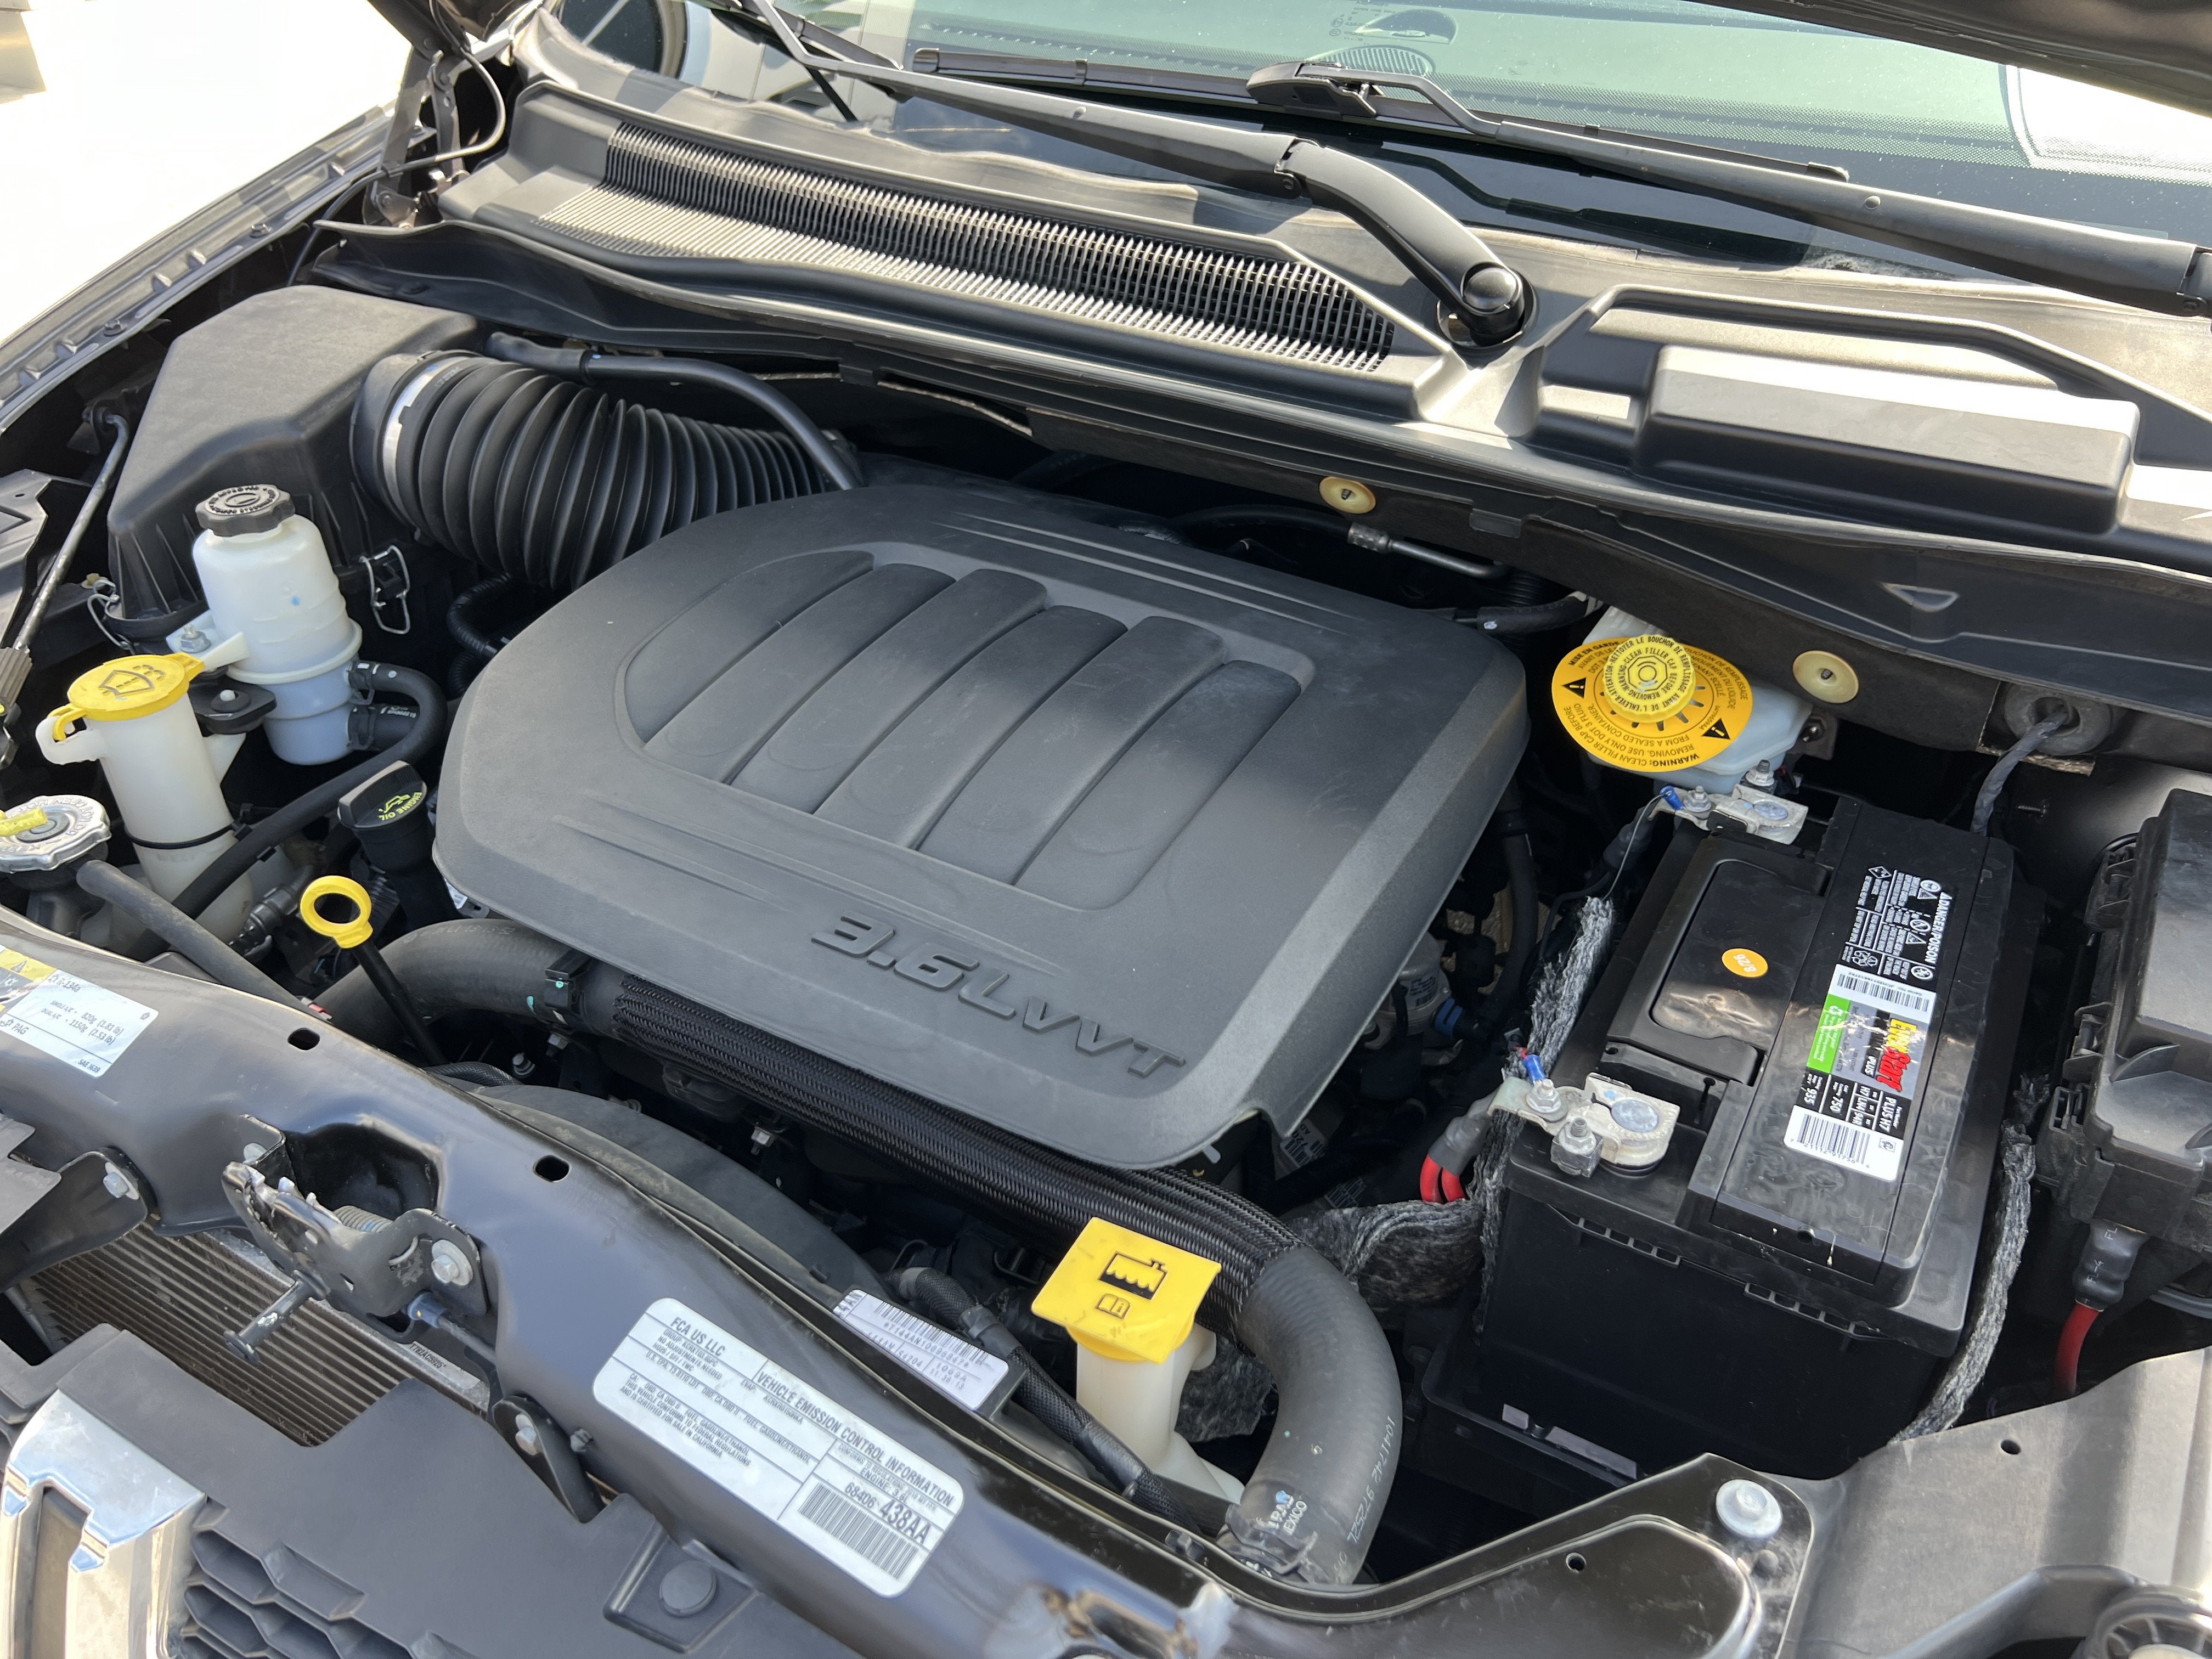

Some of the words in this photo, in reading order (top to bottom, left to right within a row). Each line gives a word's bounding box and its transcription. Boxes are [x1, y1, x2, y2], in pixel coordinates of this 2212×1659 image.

[1645, 647, 1669, 659] FILLER
[1568, 653, 1584, 666] MISE
[1685, 646, 1717, 662] OUCHON
[1724, 667, 1748, 701] REMPLISSAGE
[1647, 636, 1674, 648] BOUCHON
[1673, 646, 1683, 654] DE
[1678, 654, 1691, 693] REMPLISSAGE
[1667, 658, 1677, 670] CAP
[1578, 654, 1596, 669] AVANT
[1726, 685, 1736, 710] LIQUIDE
[1661, 673, 1678, 693] BEFORE
[1564, 706, 1583, 732] BEFORE
[1573, 703, 1588, 723] FLUID
[1580, 731, 1594, 745] CAP
[1590, 726, 1606, 741] DOT
[1623, 734, 1655, 747] SEALED
[1665, 734, 1690, 746] FROM
[1593, 741, 1618, 759] FILLER
[1605, 738, 1627, 752] ONLY
[1627, 748, 1645, 757] USE
[1647, 743, 1695, 758] REMOVING.
[1619, 755, 1647, 766] CLEAN
[1649, 753, 1700, 767] WARNING:
[396, 792, 422, 814] ENGINE
[379, 811, 396, 821] OIL
[1924, 898, 1950, 964] DANGER/POISON
[1733, 953, 1757, 973] 8/26
[57, 975, 82, 994] R-134a
[12, 1020, 29, 1036] PAG
[68, 1018, 88, 1034] 1150g
[88, 1028, 108, 1042] (2.53
[103, 1035, 116, 1046] lb)
[80, 1012, 96, 1024] 820g
[96, 1019, 116, 1032] (1.81
[111, 1025, 125, 1036] lb)
[77, 1058, 89, 1068] SAE
[86, 1063, 101, 1073] J639
[1863, 1054, 1877, 1077] PLUS
[1803, 1086, 1818, 1105] 935
[1859, 1085, 1870, 1097] H7
[1829, 1094, 1844, 1114] 750
[1855, 1096, 1867, 1111] LN4
[1880, 1095, 1896, 1120] PLUS
[1852, 1111, 1864, 1126] 94R
[1877, 1117, 1891, 1132] H7
[662, 1328, 684, 1345] GROUP:
[670, 1316, 692, 1335] FCA
[689, 1329, 707, 1345] US
[704, 1338, 726, 1357] LLC
[657, 1335, 668, 1344] NO
[665, 1340, 703, 1367] ADJUSTMENTS
[700, 1363, 723, 1380] NEEDED
[668, 1352, 679, 1362] SFI
[680, 1360, 695, 1372] TWC
[645, 1351, 658, 1362] U.S.
[713, 1395, 724, 1405] CA
[721, 1401, 735, 1412] OBD
[757, 1425, 813, 1464] GASOLINE/ETHANOL
[619, 1385, 633, 1397] AND
[629, 1392, 639, 1401] IS
[635, 1396, 663, 1418] CERTIFIED
[661, 1413, 674, 1425] FOR
[671, 1420, 687, 1434] SALE
[684, 1428, 694, 1437] IN
[690, 1432, 725, 1458] CALIFORNIA
[624, 1379, 639, 1391] THIS
[636, 1386, 659, 1404] VEHICLE
[656, 1400, 686, 1422] CONFORMS
[683, 1417, 693, 1427] TO
[690, 1422, 716, 1442] FEDERAL
[713, 1437, 753, 1466] REGULATIONS
[655, 1390, 666, 1400] CA
[663, 1395, 677, 1407] OBD
[698, 1418, 753, 1457] GASOLINE/ETHANOL
[755, 1371, 798, 1403] VEHICLE
[793, 1396, 843, 1434] EMISSION
[839, 1426, 888, 1463] CONTROL
[883, 1455, 956, 1507] INFORMATION
[837, 1442, 866, 1465] CONFORMS
[864, 1460, 873, 1469] TO
[1371, 1415, 1396, 1484] 1041742
[859, 1467, 893, 1493] ENGINE:
[890, 1488, 911, 1504] 3.6L
[842, 1481, 879, 1510] 68406
[875, 1496, 936, 1545] 438AA
[1283, 1500, 1308, 1536] EXICO
